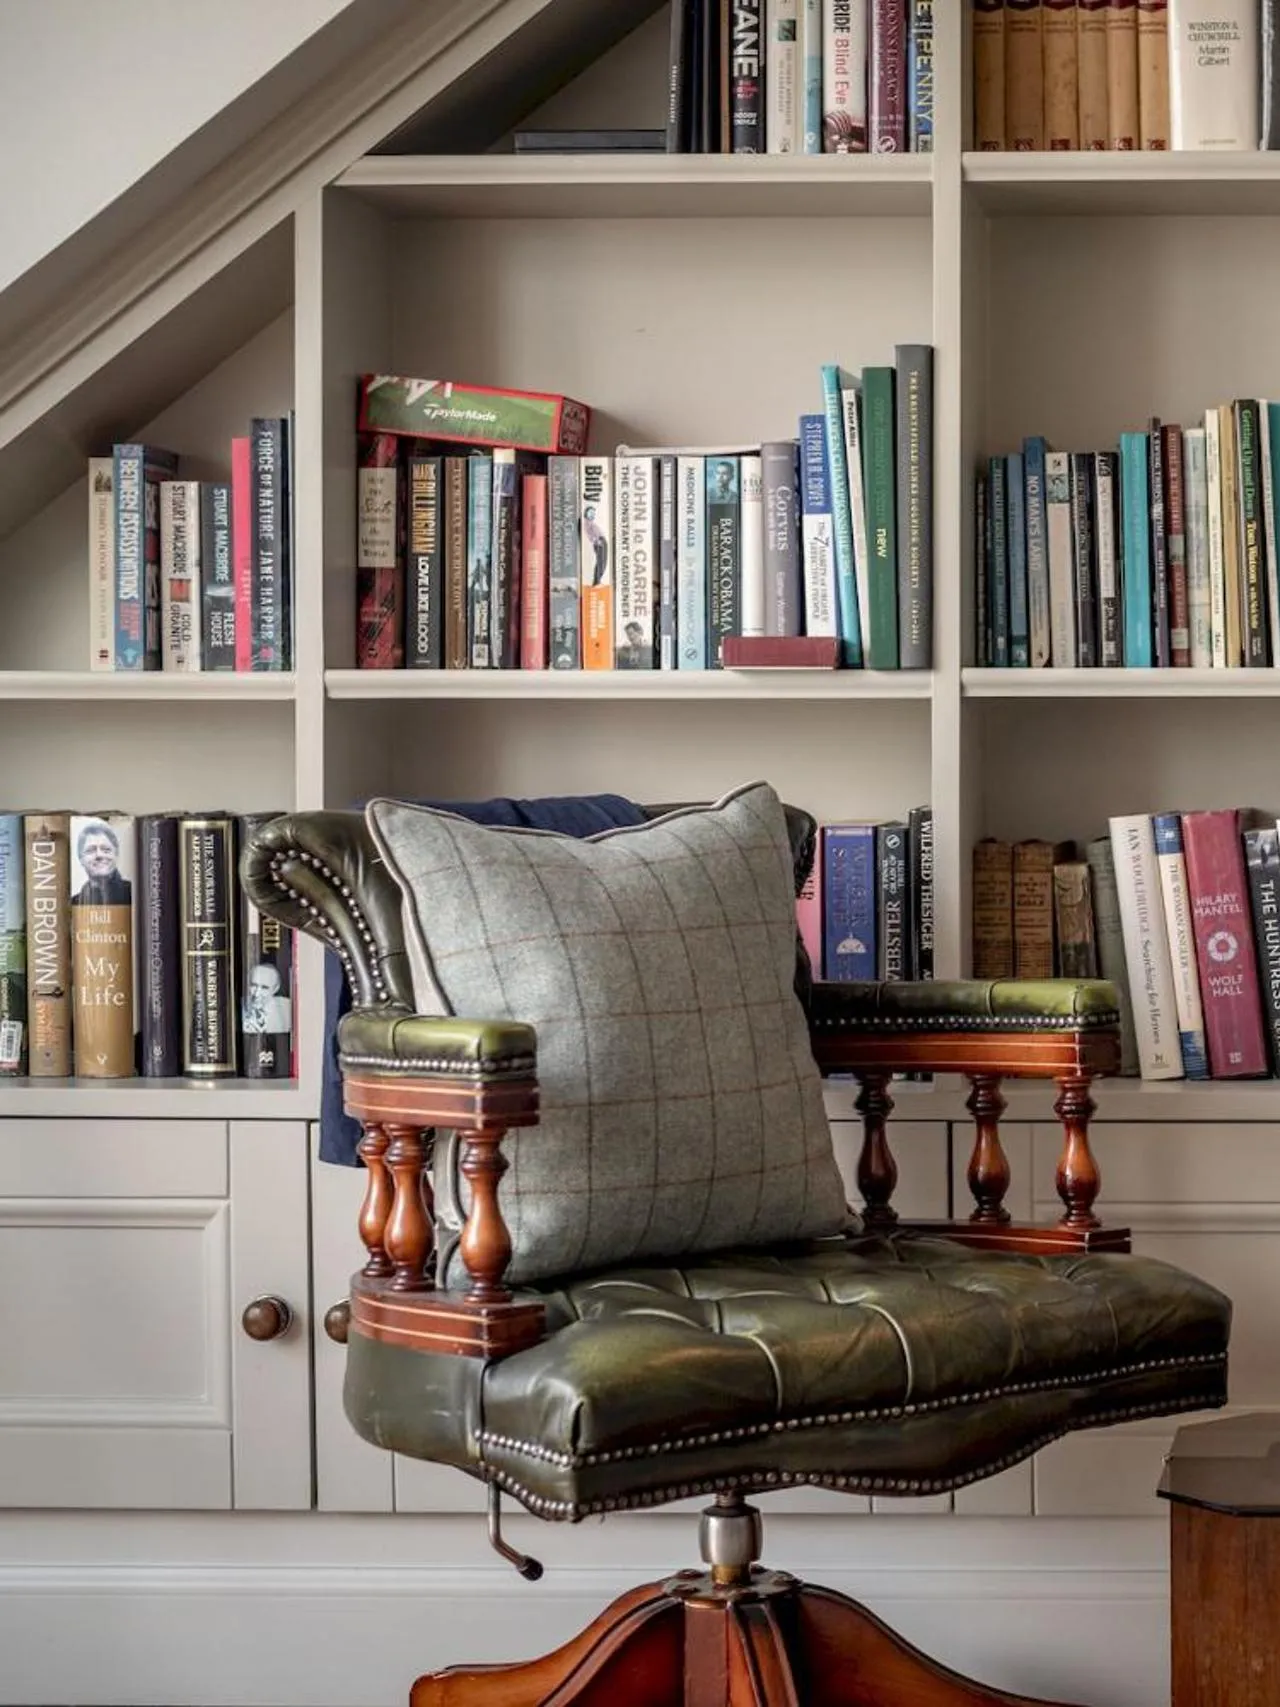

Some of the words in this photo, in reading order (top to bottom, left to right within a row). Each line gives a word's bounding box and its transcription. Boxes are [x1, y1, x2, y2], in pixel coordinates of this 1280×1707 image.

[835, 38, 848, 75] Blind
[1198, 56, 1230, 66] Gilbert
[1199, 45, 1229, 54] Martin
[910, 371, 919, 389] THE
[846, 401, 856, 424] Peter
[1240, 410, 1253, 449] Getting
[259, 431, 274, 471] FORCE
[806, 423, 823, 464] STEPHEN
[584, 465, 603, 502] Billy
[621, 465, 630, 488] THE
[633, 465, 648, 520] JOHN
[686, 466, 696, 513] MEDICINE
[809, 477, 824, 508] COVEY
[1027, 475, 1039, 494] NO
[172, 484, 187, 520] STUART
[213, 488, 230, 526] STUART
[259, 488, 274, 540] NATURE
[413, 481, 437, 553] BILLINGHAM
[776, 485, 792, 551] Corvus
[1245, 488, 1256, 519] Down
[621, 491, 630, 551] CONSTANT
[634, 528, 648, 544] le
[686, 518, 696, 547] BALLS
[1246, 521, 1258, 545] Tom
[720, 518, 733, 577] BARACK
[875, 528, 889, 557] new
[259, 550, 274, 581] JANE
[418, 556, 429, 584] LOVE
[910, 547, 919, 588] SOCIETY
[1247, 546, 1260, 584] Watson
[418, 587, 429, 610] LIKE
[621, 556, 630, 617] GARDENER
[259, 587, 274, 640] HARPER
[720, 578, 733, 633] OBAMA
[171, 604, 181, 651] GRANITE
[181, 612, 191, 641] COLD
[211, 610, 223, 648] HOUSE
[223, 611, 234, 645] FLESH
[418, 613, 429, 653] BLOOD
[920, 821, 933, 882] WILFRED
[1128, 829, 1140, 851] IAN
[33, 841, 56, 890] DAN
[1168, 864, 1181, 883] THE
[1193, 903, 1243, 917] MANTEL
[1260, 880, 1277, 915] THE
[90, 910, 111, 923] Bill
[920, 885, 933, 950] THESIGER
[34, 896, 58, 986] BROWN
[77, 931, 127, 944] Clinton
[83, 955, 120, 982] My
[1141, 940, 1158, 990] Searching
[1208, 974, 1243, 987] WOLF
[81, 985, 126, 1006] Life
[206, 960, 218, 1006] WARREN
[1146, 992, 1159, 1006] for
[1212, 986, 1243, 998] HALL
